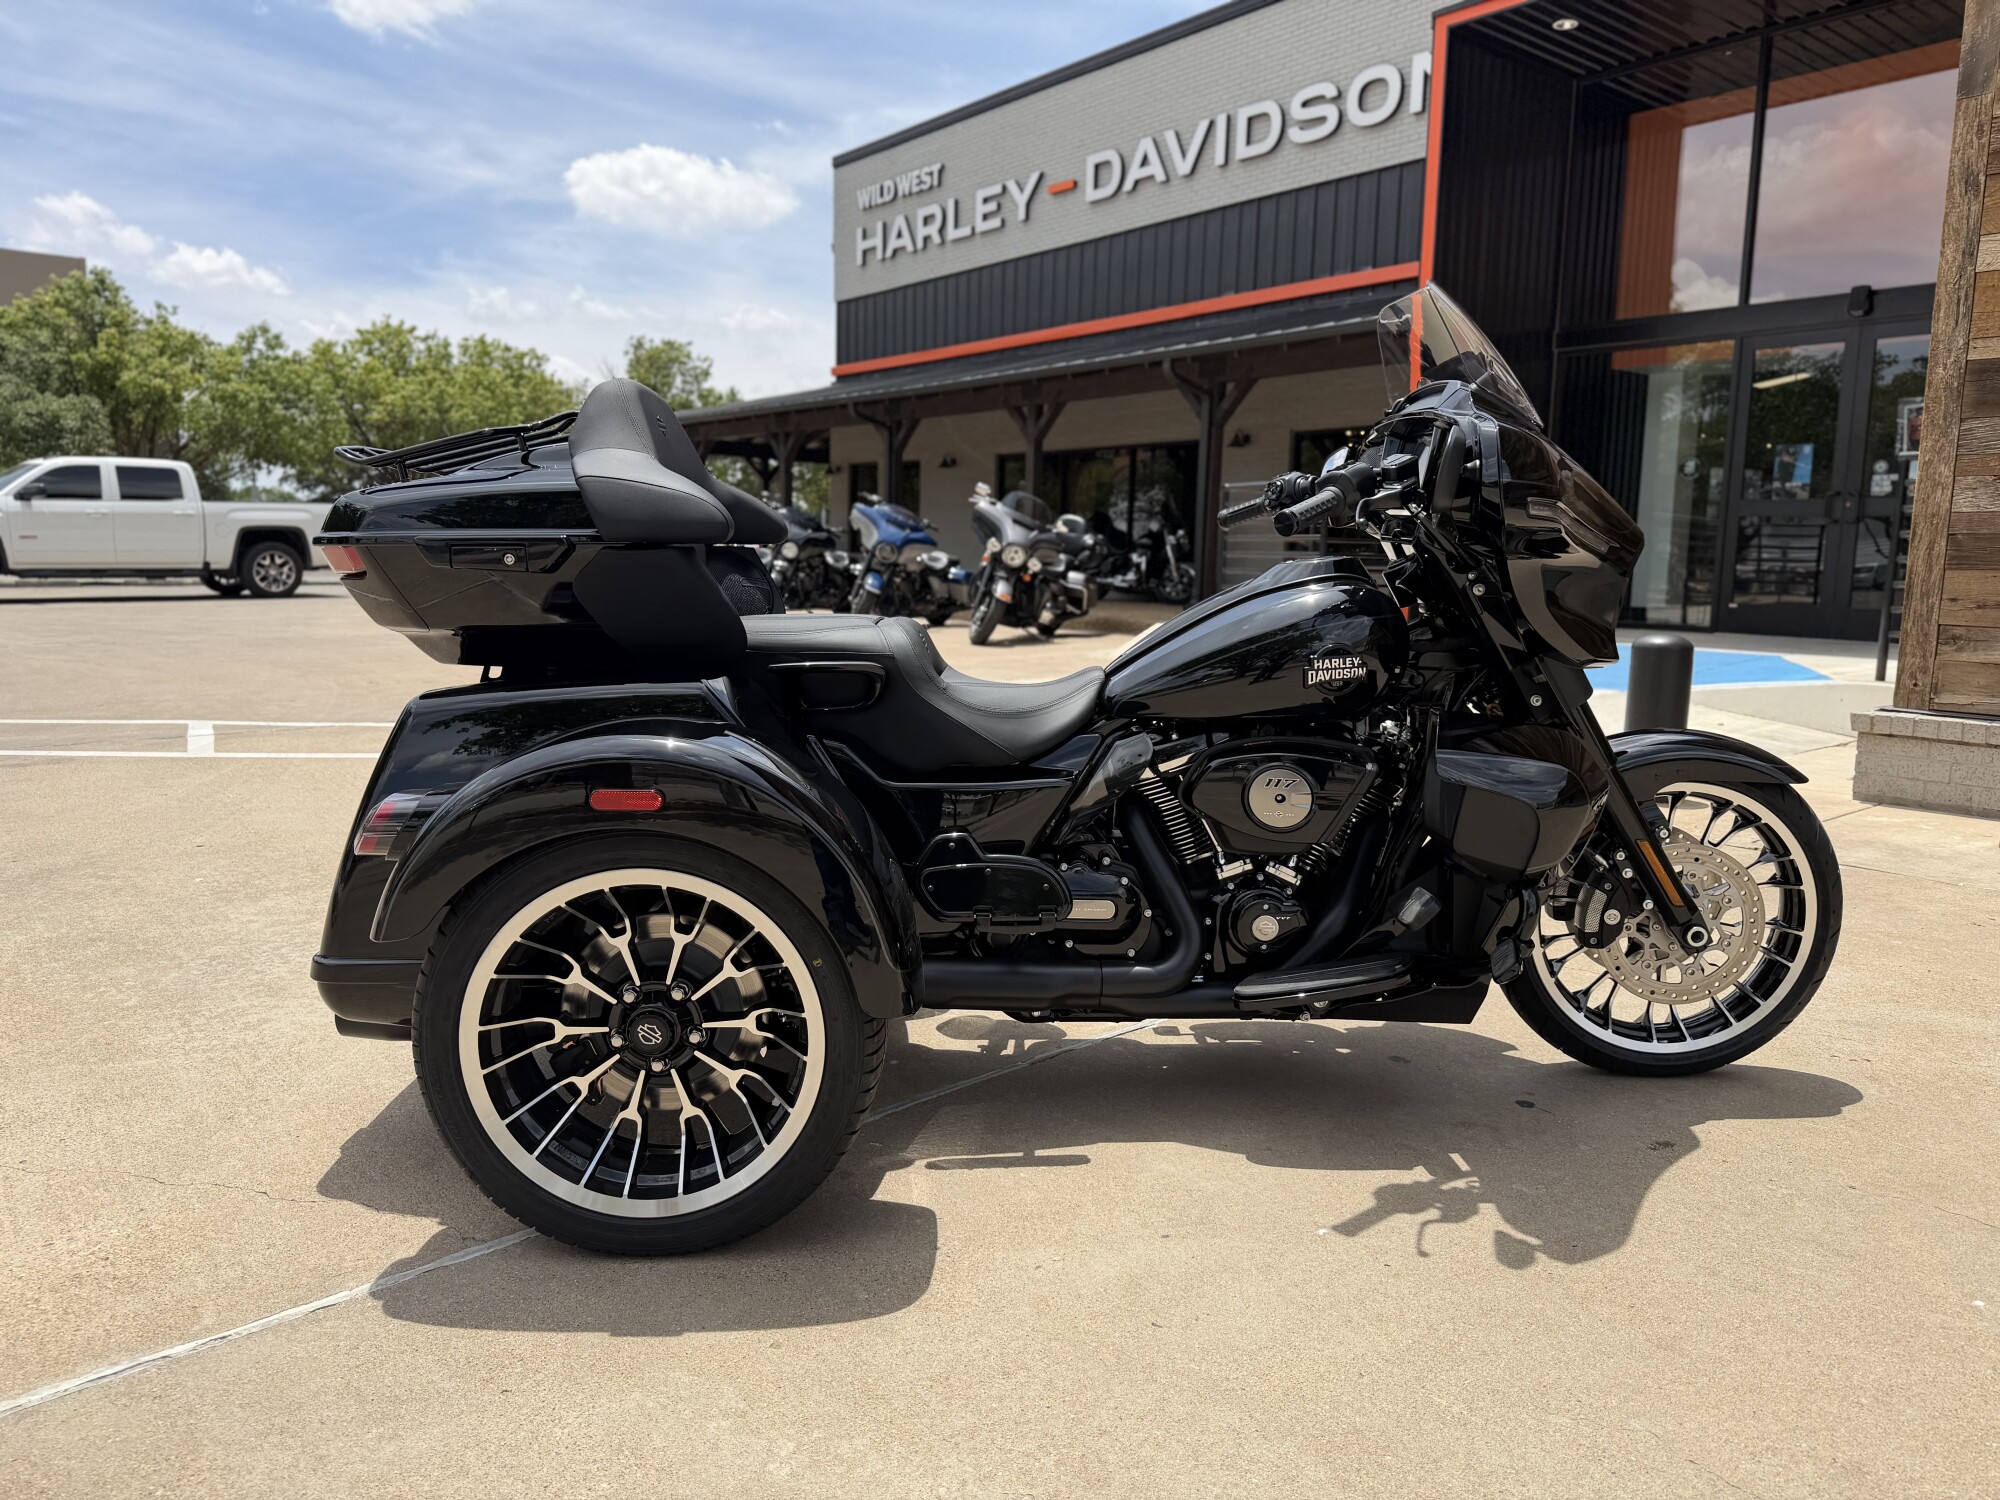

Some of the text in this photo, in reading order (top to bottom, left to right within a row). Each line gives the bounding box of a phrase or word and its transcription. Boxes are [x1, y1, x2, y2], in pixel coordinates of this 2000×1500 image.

[857, 162, 944, 210] WILD WEST
[1308, 667, 1366, 685] DAVIDSON
[1264, 778, 1299, 788] 117
